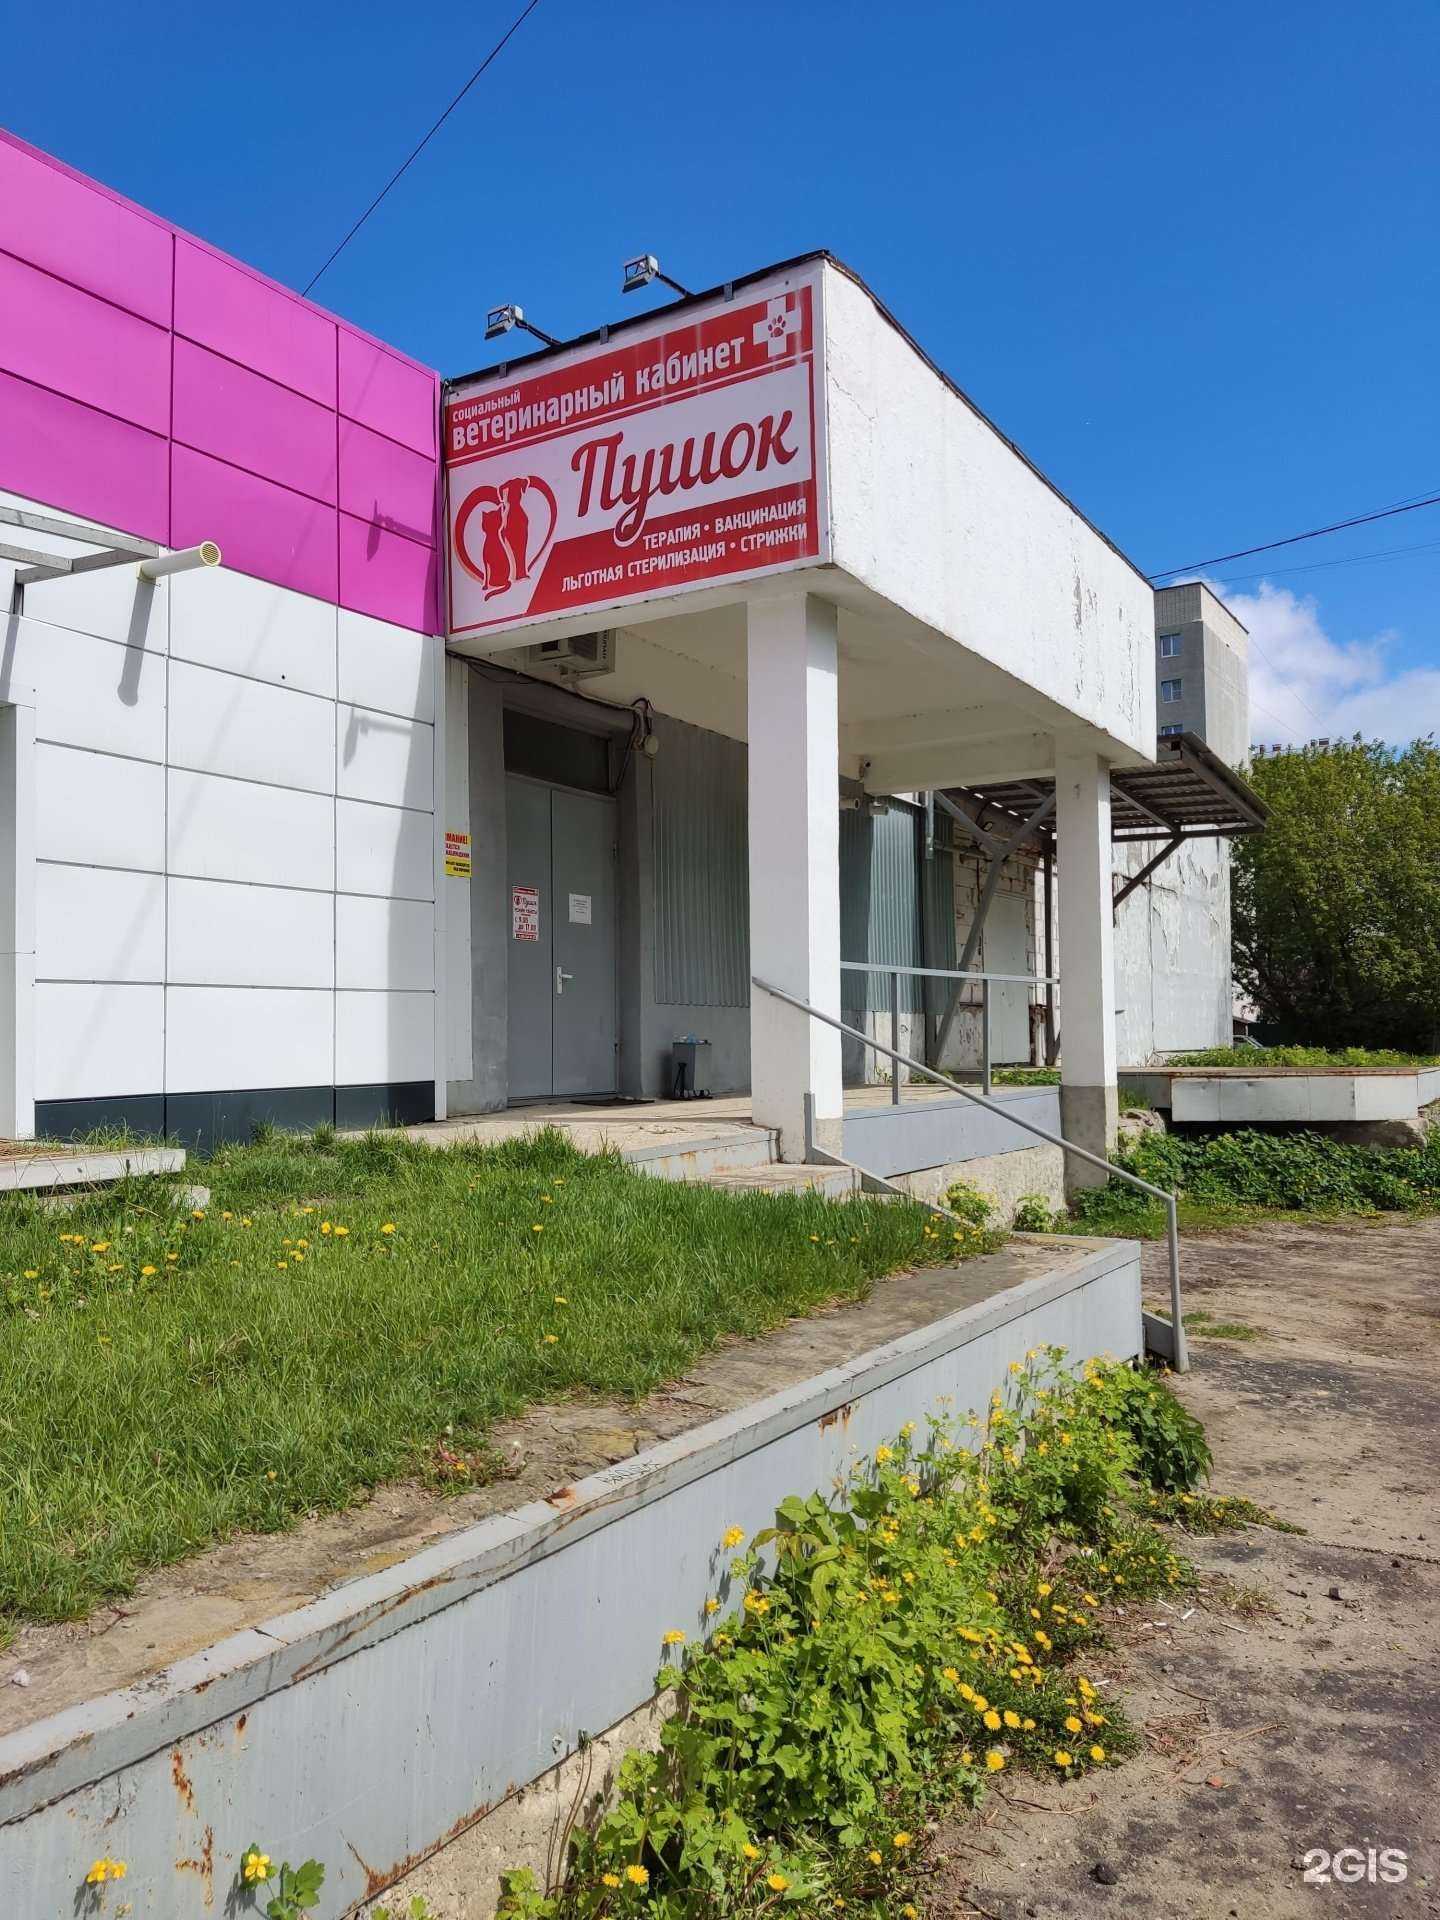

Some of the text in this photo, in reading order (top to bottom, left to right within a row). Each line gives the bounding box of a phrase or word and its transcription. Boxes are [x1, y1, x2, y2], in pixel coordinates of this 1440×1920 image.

[452, 336, 745, 450] ветеринарный кабинет
[452, 389, 521, 422] социальный
[570, 410, 799, 543] Пушок
[561, 523, 808, 593] ЛЬГОТНАЯ СТЕРИЛИЗАЦИЯ СТРИЖКИ
[642, 498, 807, 551] ТЕРАПИЯ ВАКЦИНАЦИЯ
